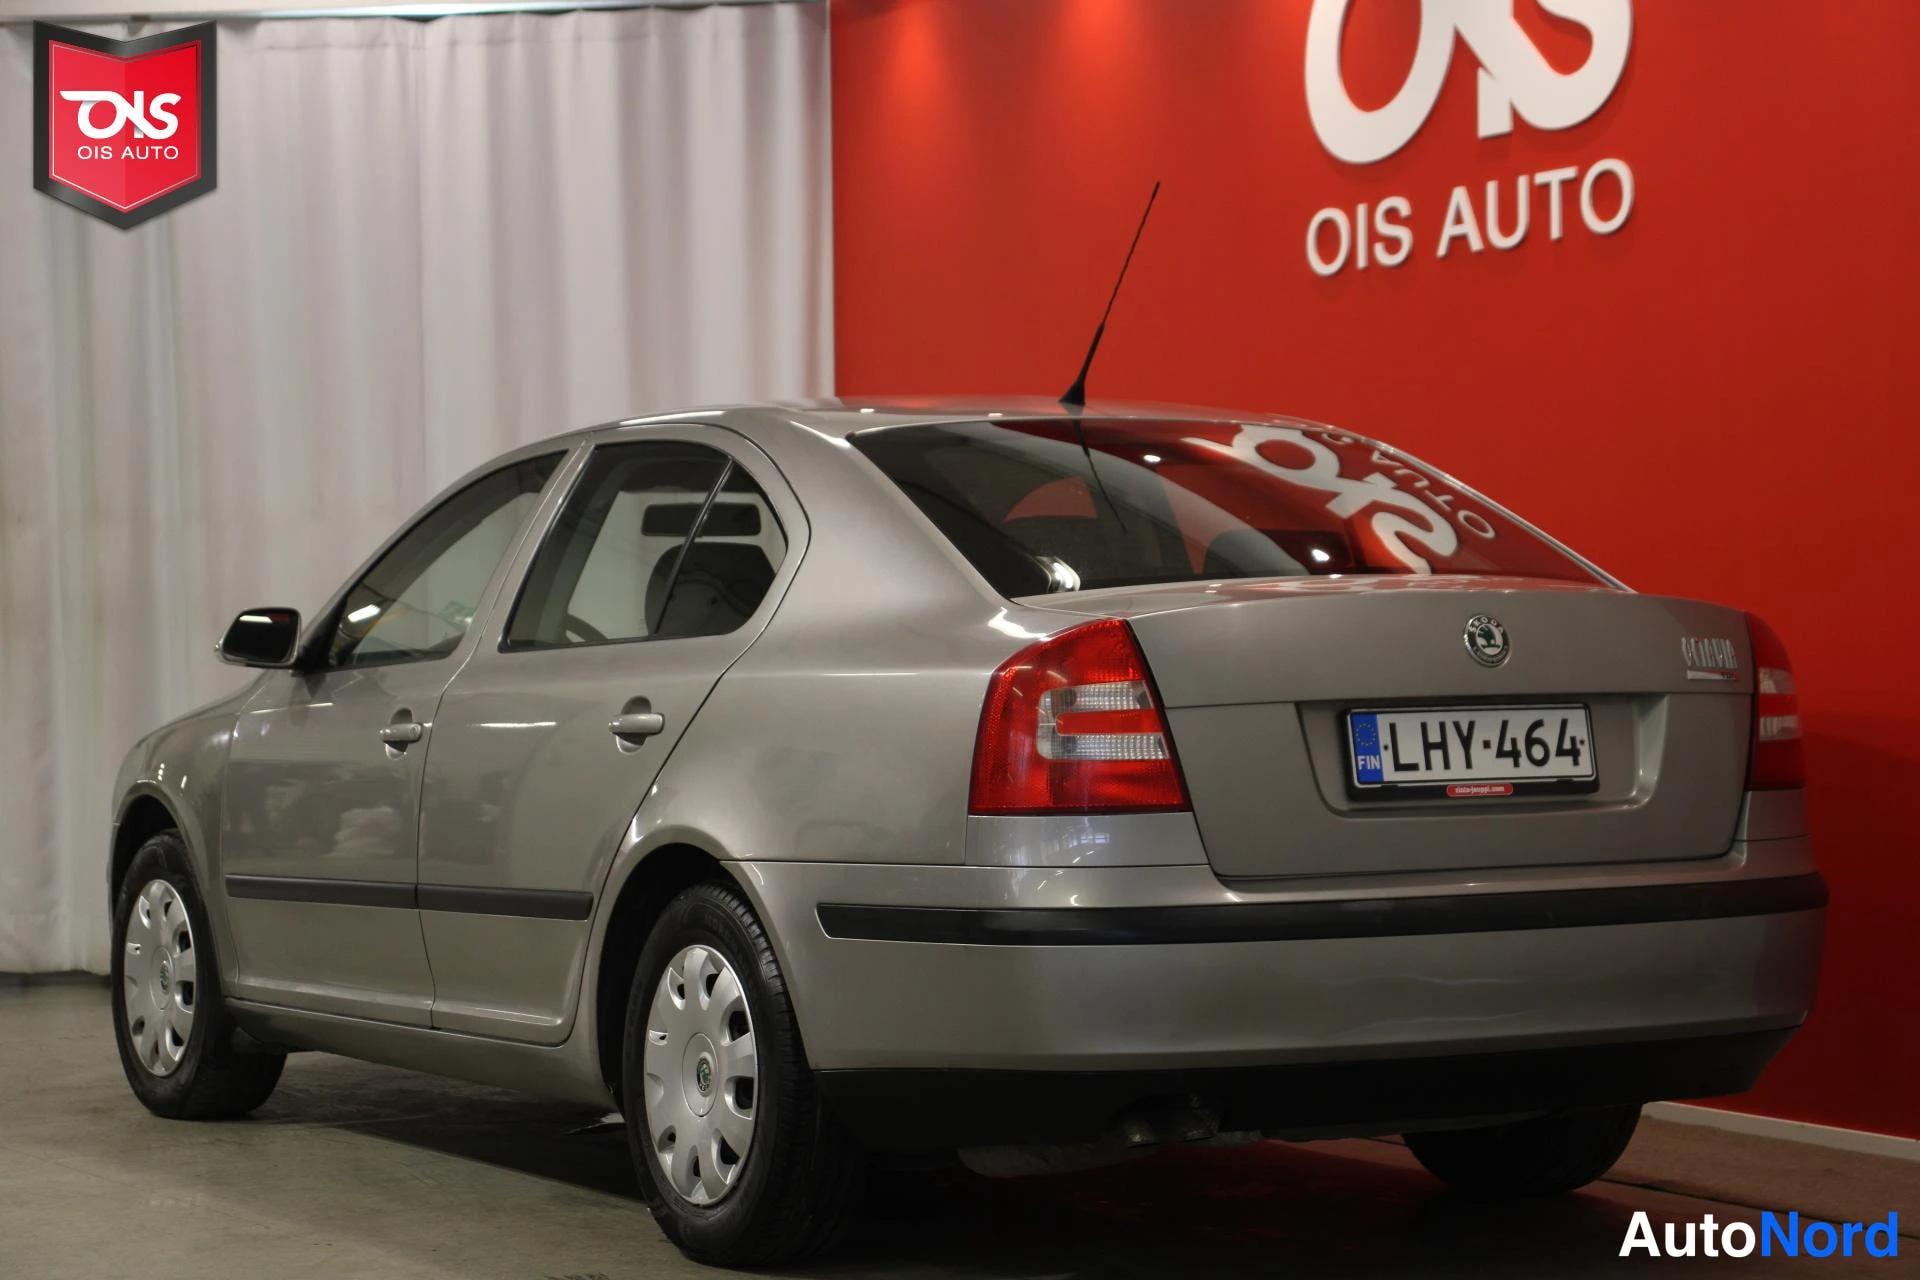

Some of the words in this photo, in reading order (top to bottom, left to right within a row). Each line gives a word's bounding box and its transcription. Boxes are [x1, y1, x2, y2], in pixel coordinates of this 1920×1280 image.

[1306, 196, 1414, 277] OIS
[1436, 157, 1635, 258] AUTO
[1357, 755, 1381, 770] FIN
[1388, 718, 1582, 772] LHY-464
